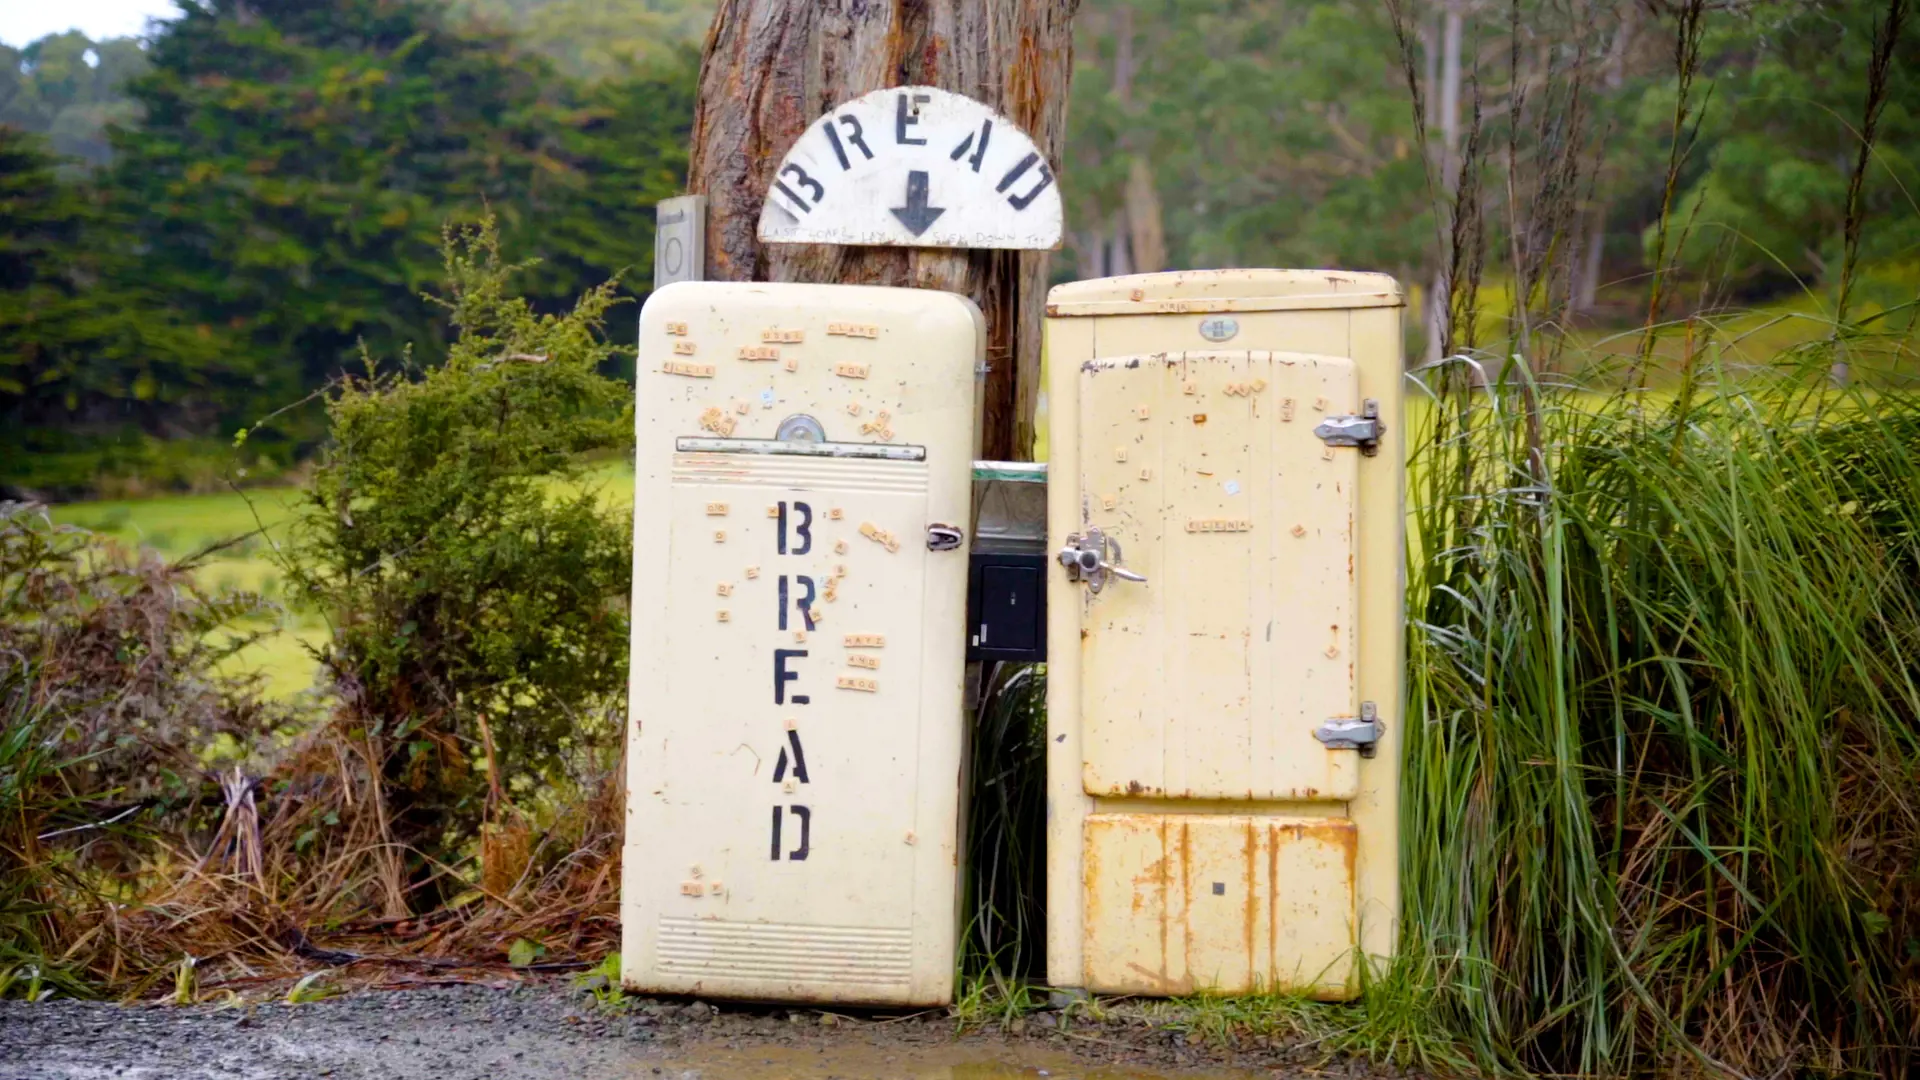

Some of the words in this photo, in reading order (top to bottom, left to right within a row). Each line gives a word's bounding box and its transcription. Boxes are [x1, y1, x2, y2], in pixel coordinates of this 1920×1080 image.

[776, 94, 1053, 213] BREAD
[1186, 520, 1249, 532] ELENA
[771, 501, 815, 860] BREAD
